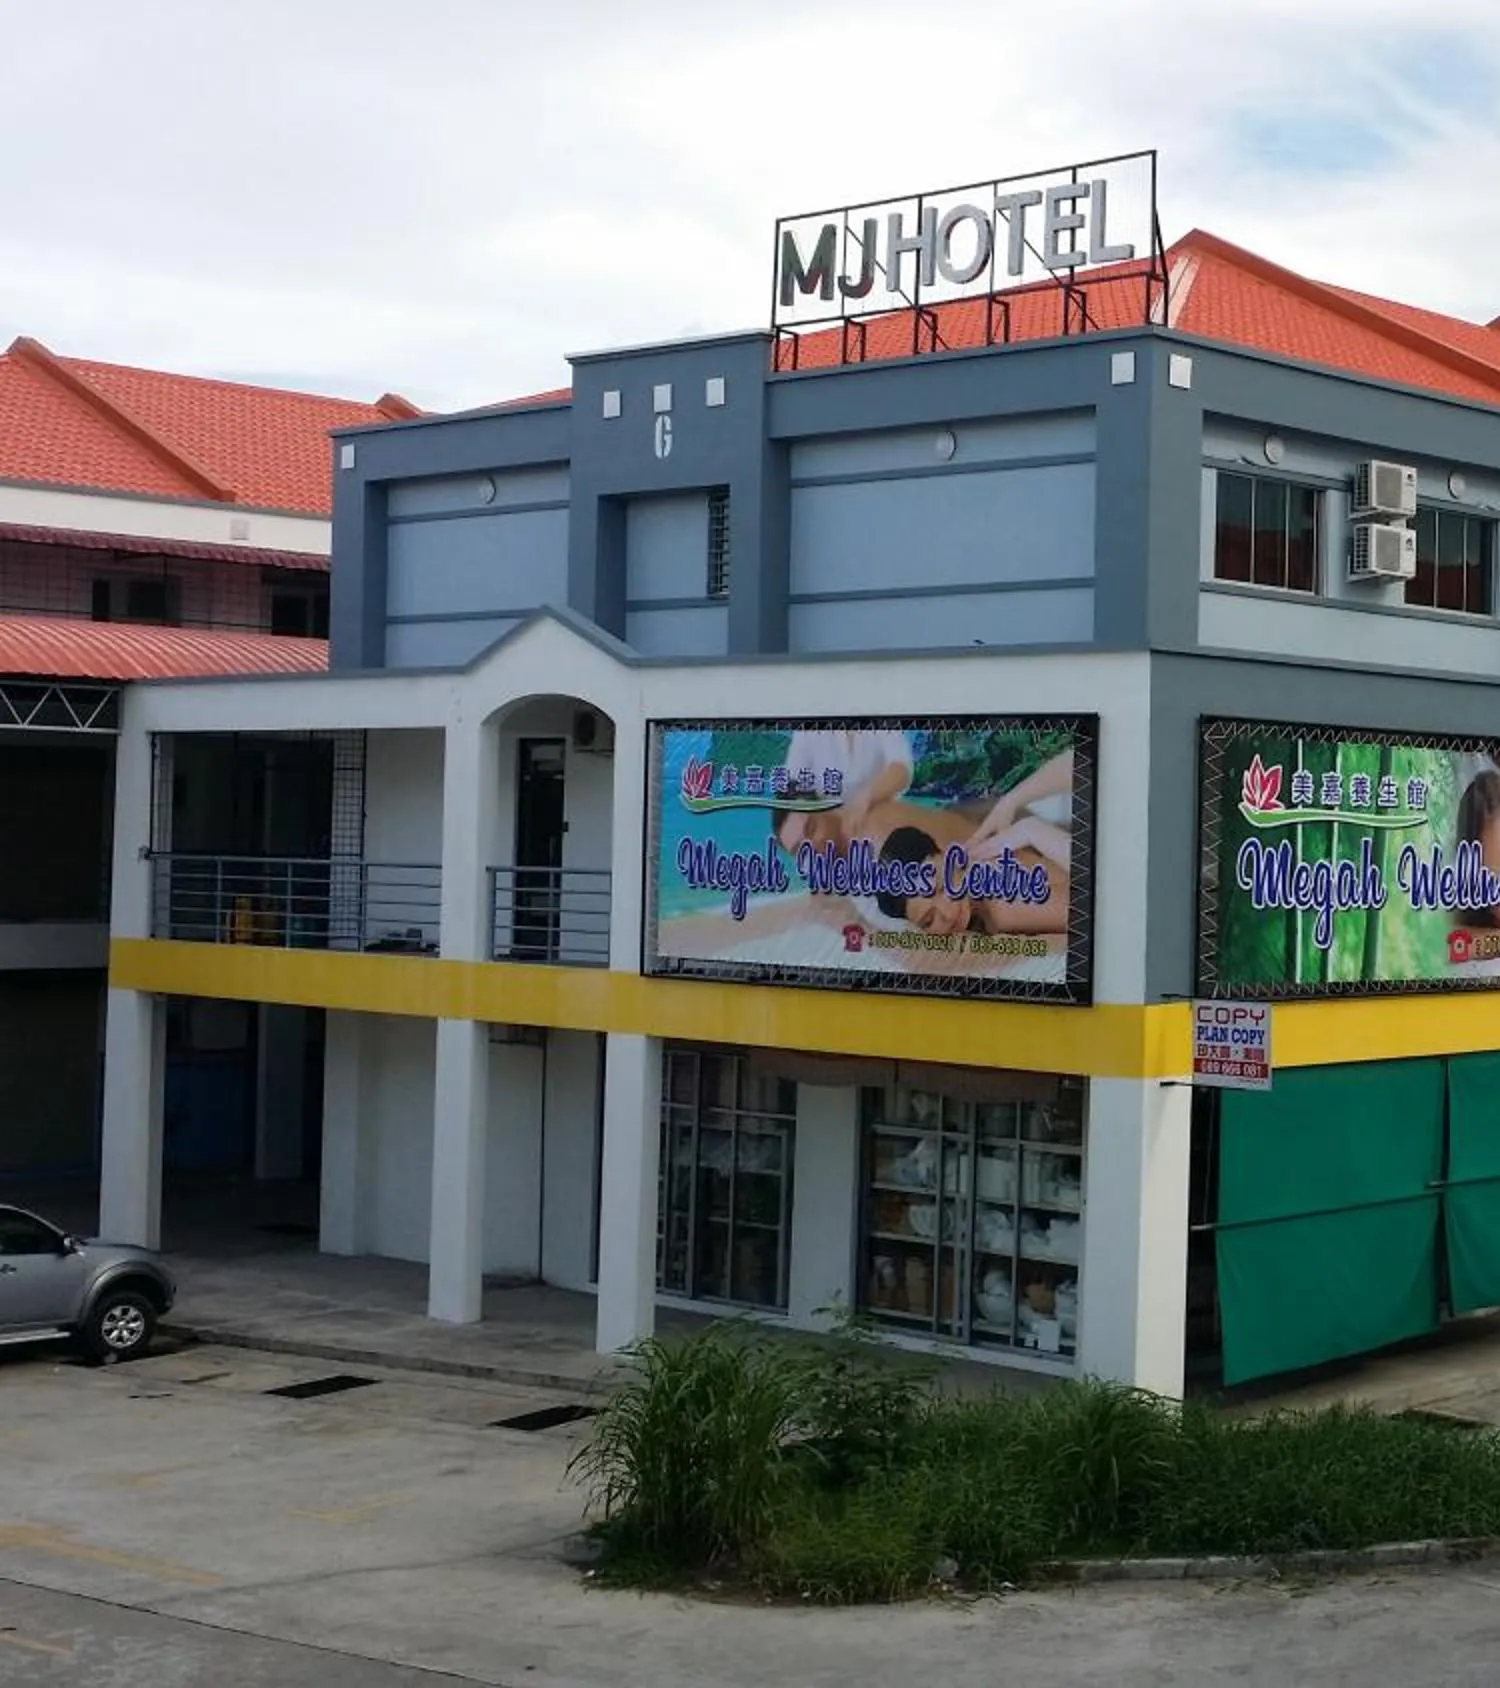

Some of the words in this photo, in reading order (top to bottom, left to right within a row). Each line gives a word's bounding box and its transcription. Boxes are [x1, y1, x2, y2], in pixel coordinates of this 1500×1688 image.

[677, 835, 789, 921] Megah
[797, 840, 937, 897] Wellness
[942, 843, 1051, 904] Centre
[1236, 836, 1387, 948] Megah
[1197, 1005, 1265, 1026] COPY
[1197, 1025, 1229, 1043] PLAN
[1231, 1028, 1265, 1045] COPY
